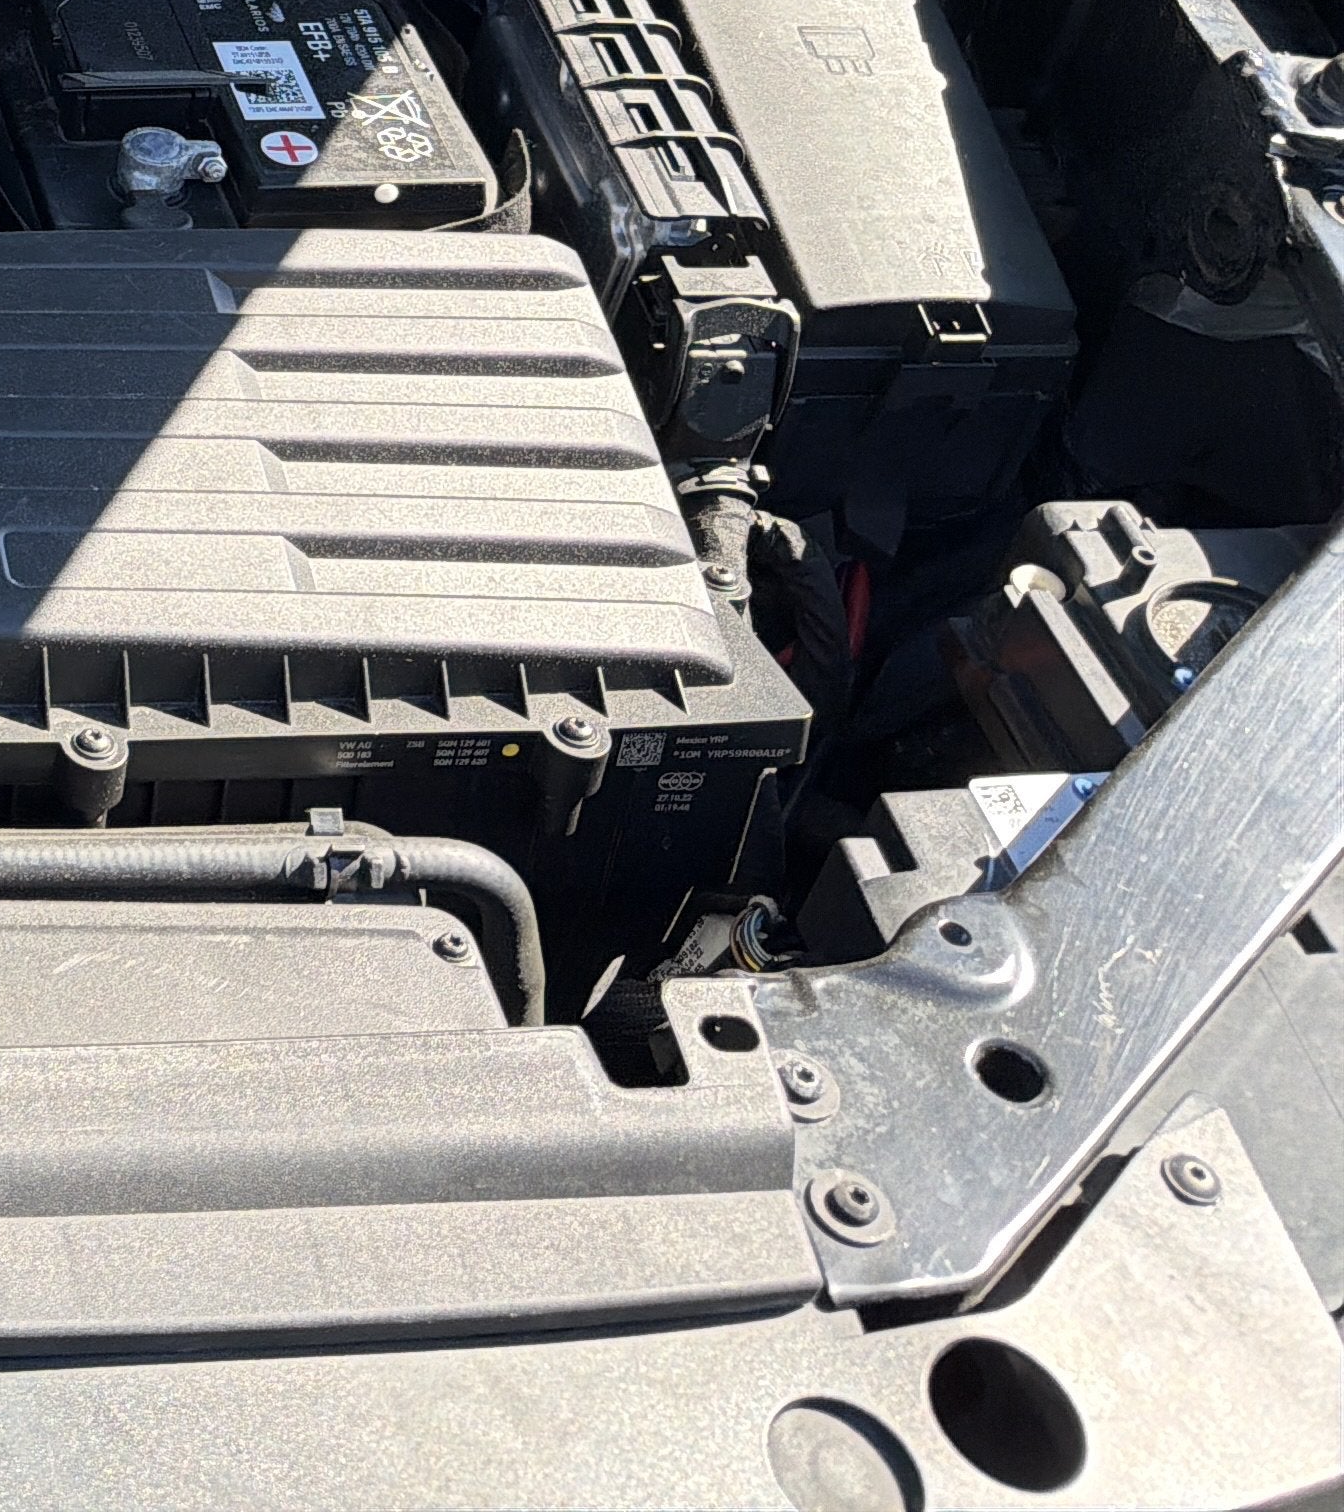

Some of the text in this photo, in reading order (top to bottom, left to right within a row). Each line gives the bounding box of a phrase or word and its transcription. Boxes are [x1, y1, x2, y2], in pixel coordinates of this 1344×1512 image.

[353, 8, 374, 25] 5TA
[363, 27, 383, 44] 915
[298, 22, 332, 62] EFB+
[373, 47, 393, 63] 105
[326, 101, 348, 118] Pb
[459, 739, 474, 747] 129
[676, 735, 729, 744] Mexico YRP
[339, 741, 358, 750] VW
[457, 749, 472, 757] 129
[336, 759, 394, 769] Filterelement
[455, 758, 470, 766] 129
